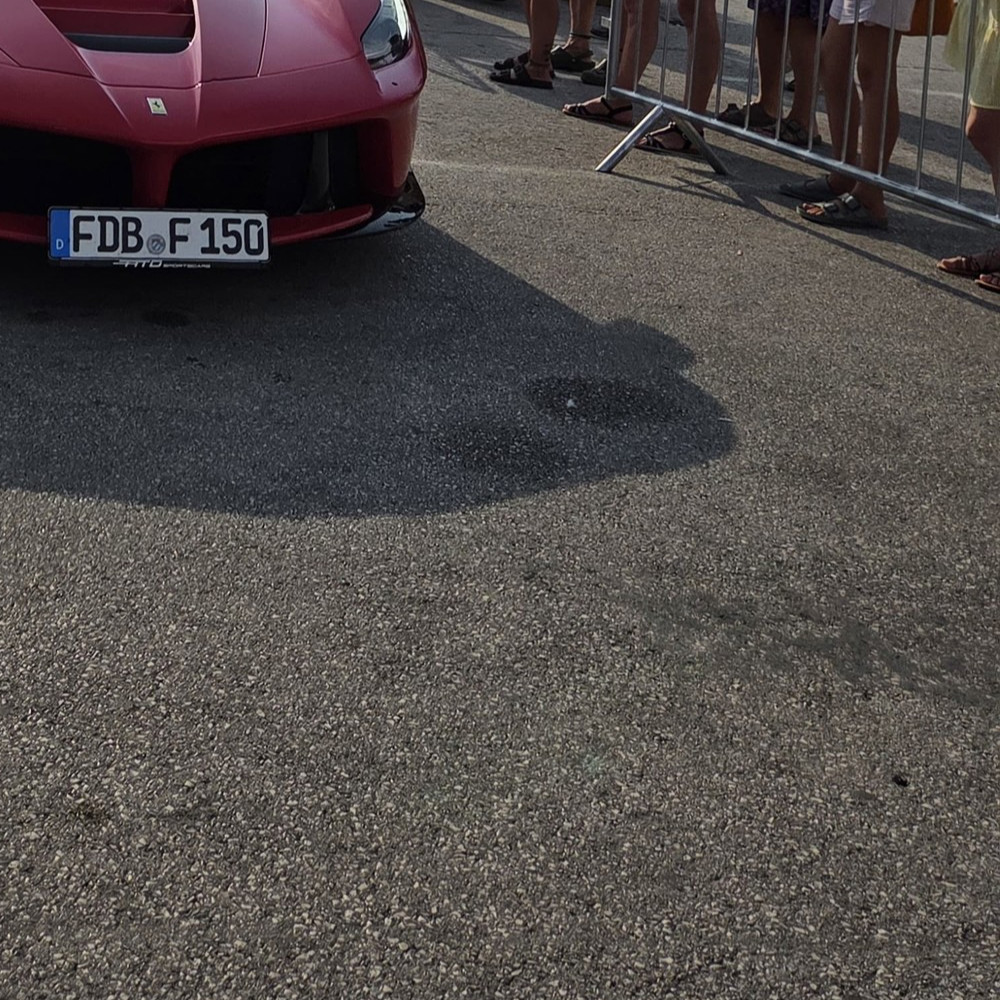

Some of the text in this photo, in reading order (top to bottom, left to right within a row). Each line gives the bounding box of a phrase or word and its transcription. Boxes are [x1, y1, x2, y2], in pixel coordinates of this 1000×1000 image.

[55, 238, 64, 250] D
[72, 215, 264, 256] FDB F 150
